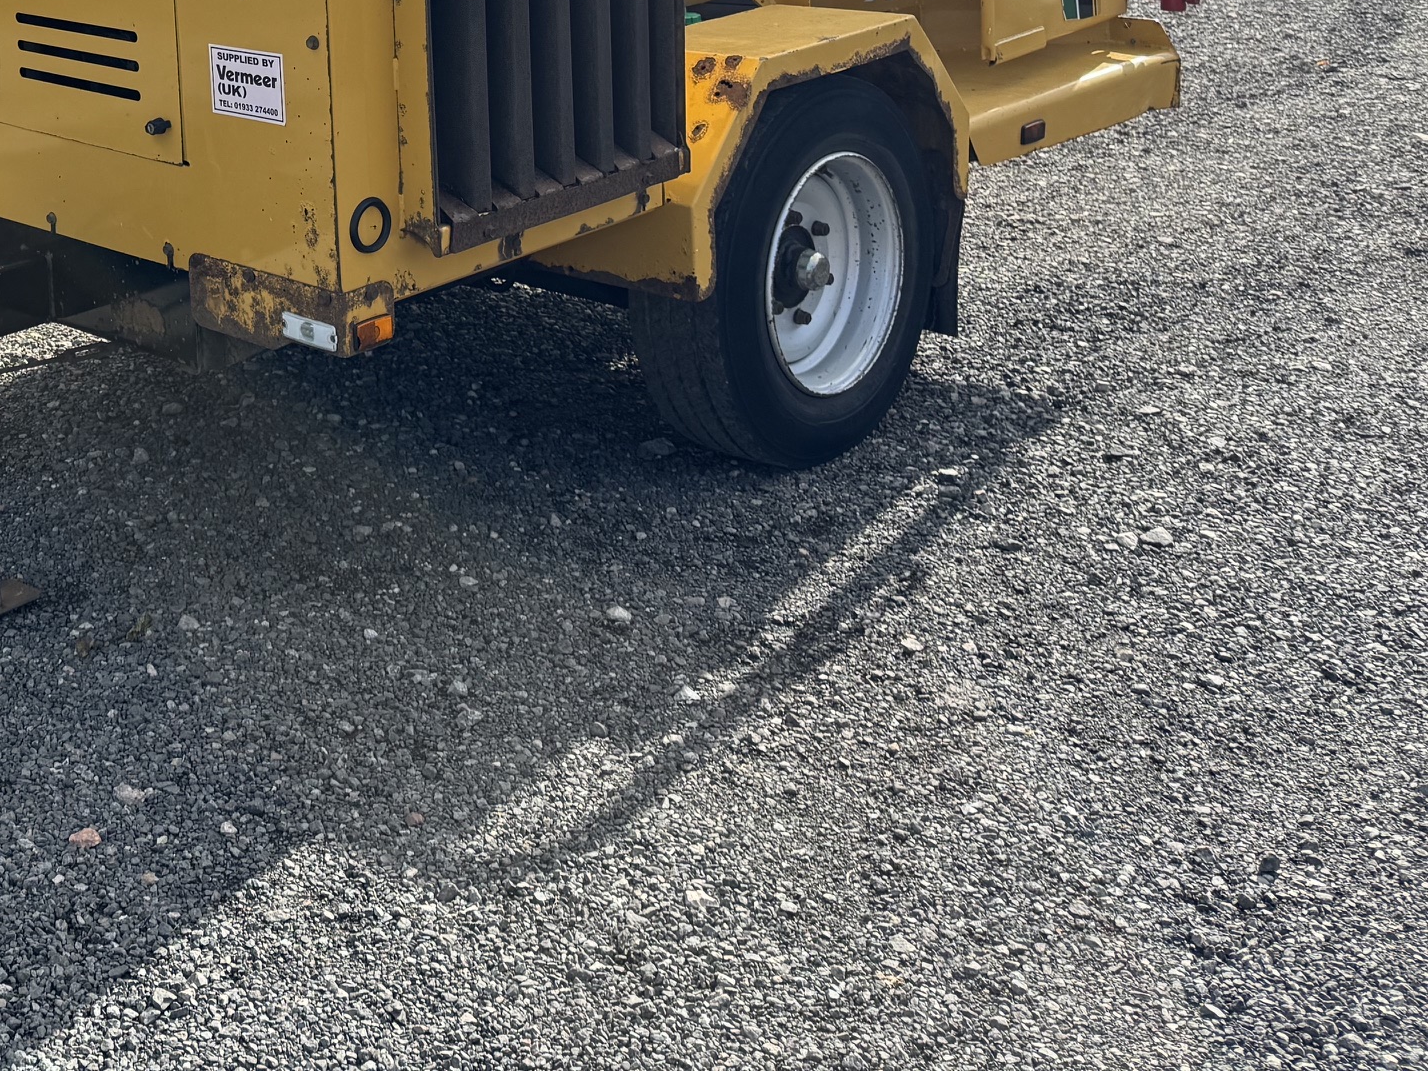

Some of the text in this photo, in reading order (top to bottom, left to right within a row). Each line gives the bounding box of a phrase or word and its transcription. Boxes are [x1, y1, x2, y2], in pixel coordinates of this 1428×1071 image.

[217, 51, 275, 68] SUPPLIED BY
[216, 63, 278, 89] Vermeer
[218, 82, 247, 99] (UK)
[219, 98, 279, 117] TEL: 01933 274400
